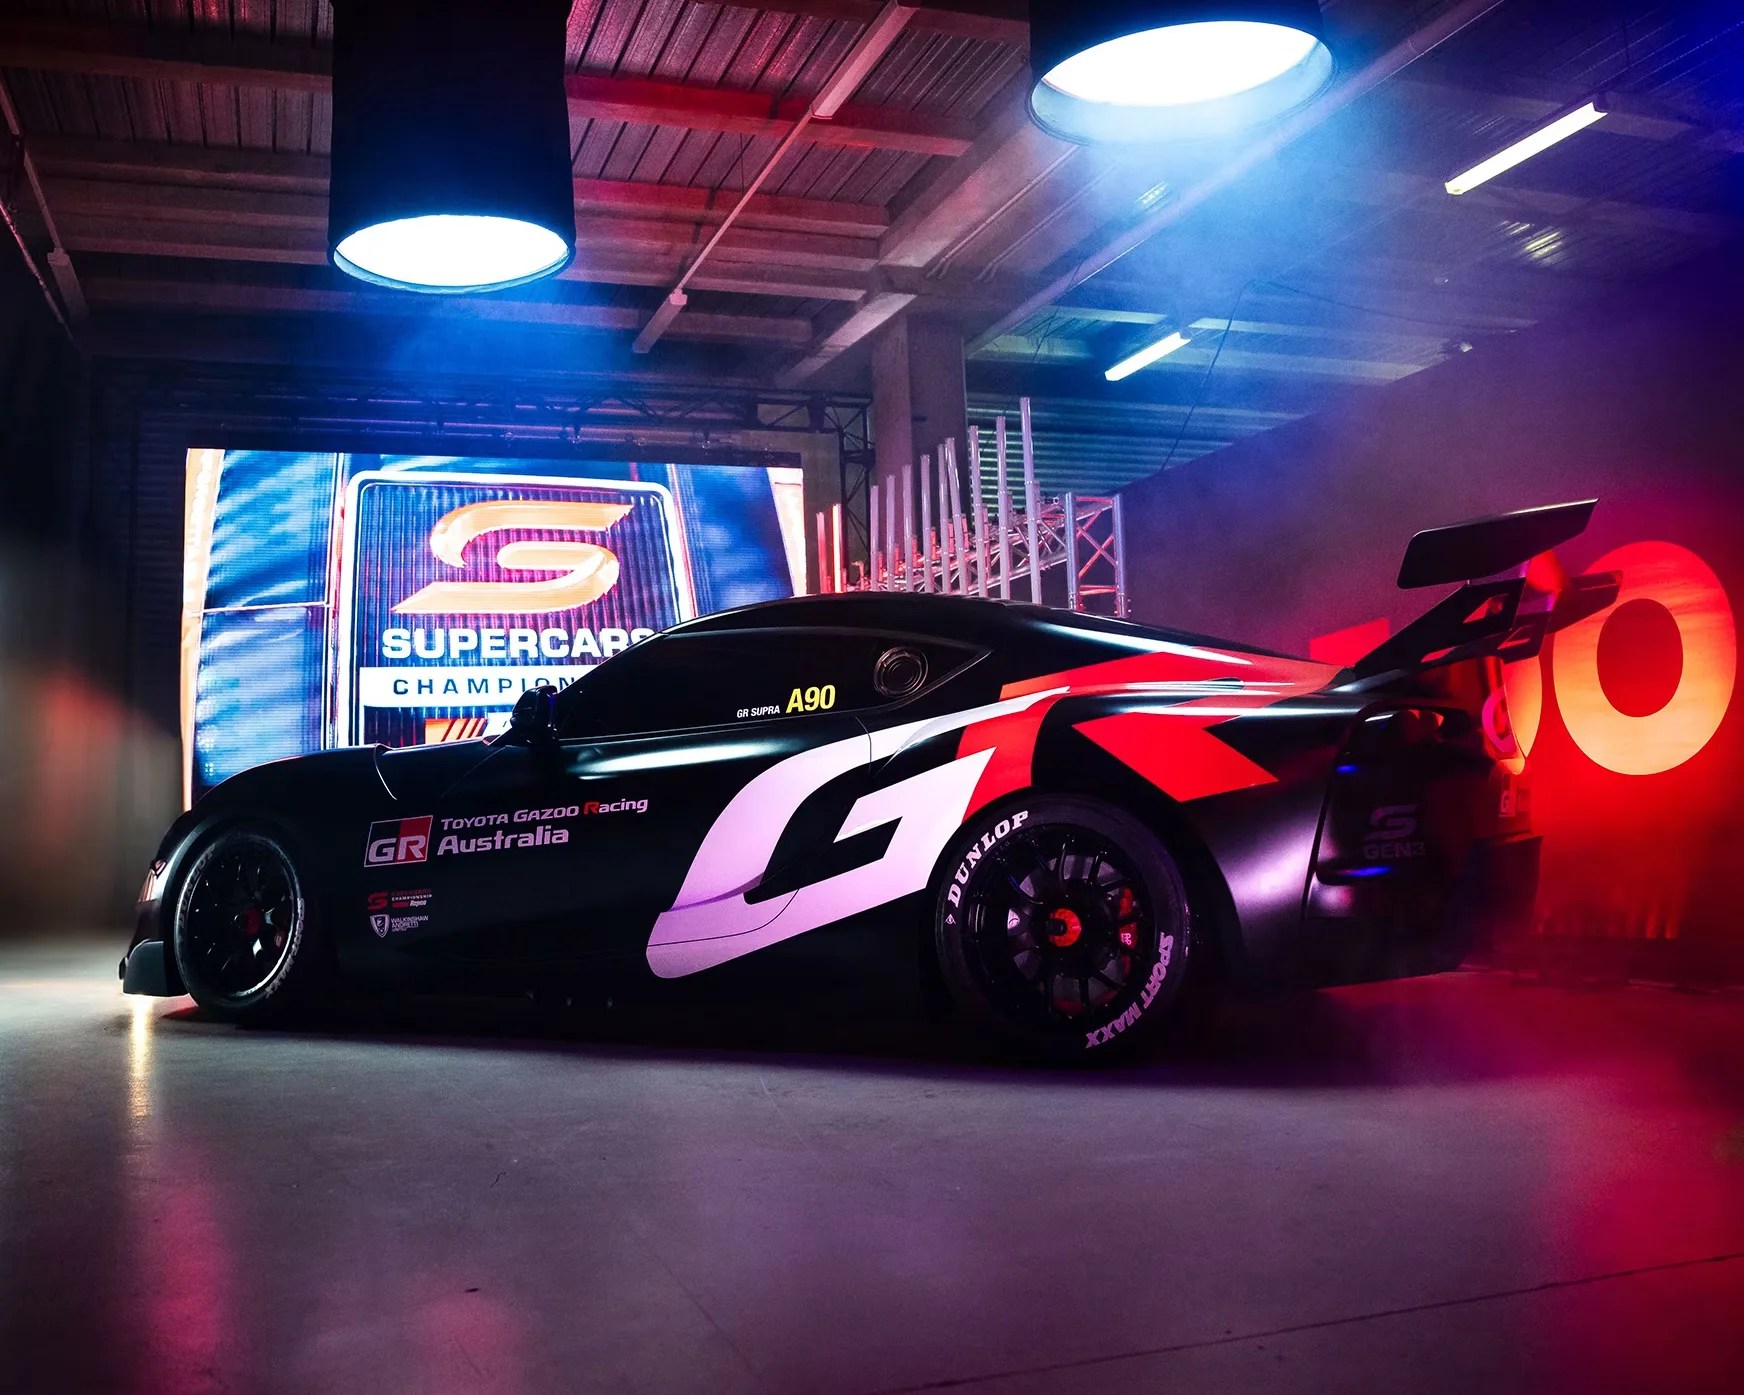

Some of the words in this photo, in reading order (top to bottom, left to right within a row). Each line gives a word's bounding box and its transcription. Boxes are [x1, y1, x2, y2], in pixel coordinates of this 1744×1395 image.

[736, 708, 749, 718] GR
[750, 705, 780, 717] SUPRA
[785, 684, 836, 714] A90
[441, 813, 509, 831] TOYOTA
[513, 805, 580, 823] GAZOO
[584, 798, 649, 816] Racing
[367, 834, 426, 863] GR
[437, 825, 570, 856] Australia
[1363, 840, 1427, 861] GEN3
[947, 810, 1029, 908] DUNLOP
[1140, 931, 1174, 1010] SPORT
[1085, 1002, 1143, 1049] MAXX
